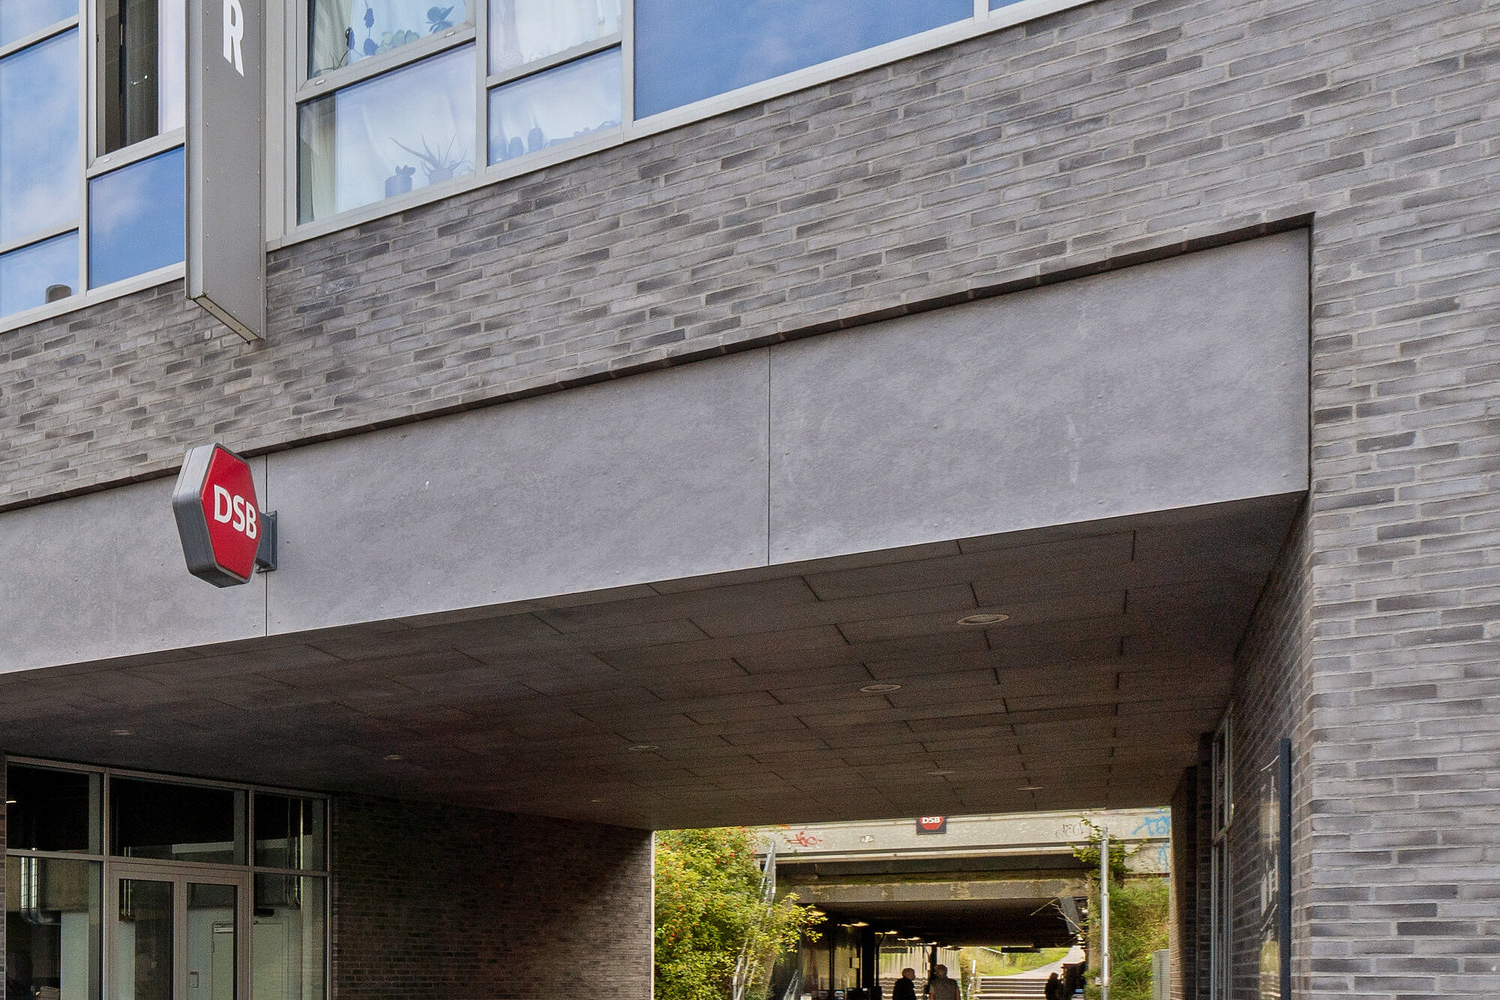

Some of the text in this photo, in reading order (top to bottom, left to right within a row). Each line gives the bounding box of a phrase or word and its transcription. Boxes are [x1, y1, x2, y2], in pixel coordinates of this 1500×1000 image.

[223, 0, 244, 77] R
[213, 484, 257, 540] DSB
[922, 816, 941, 824] DSB
